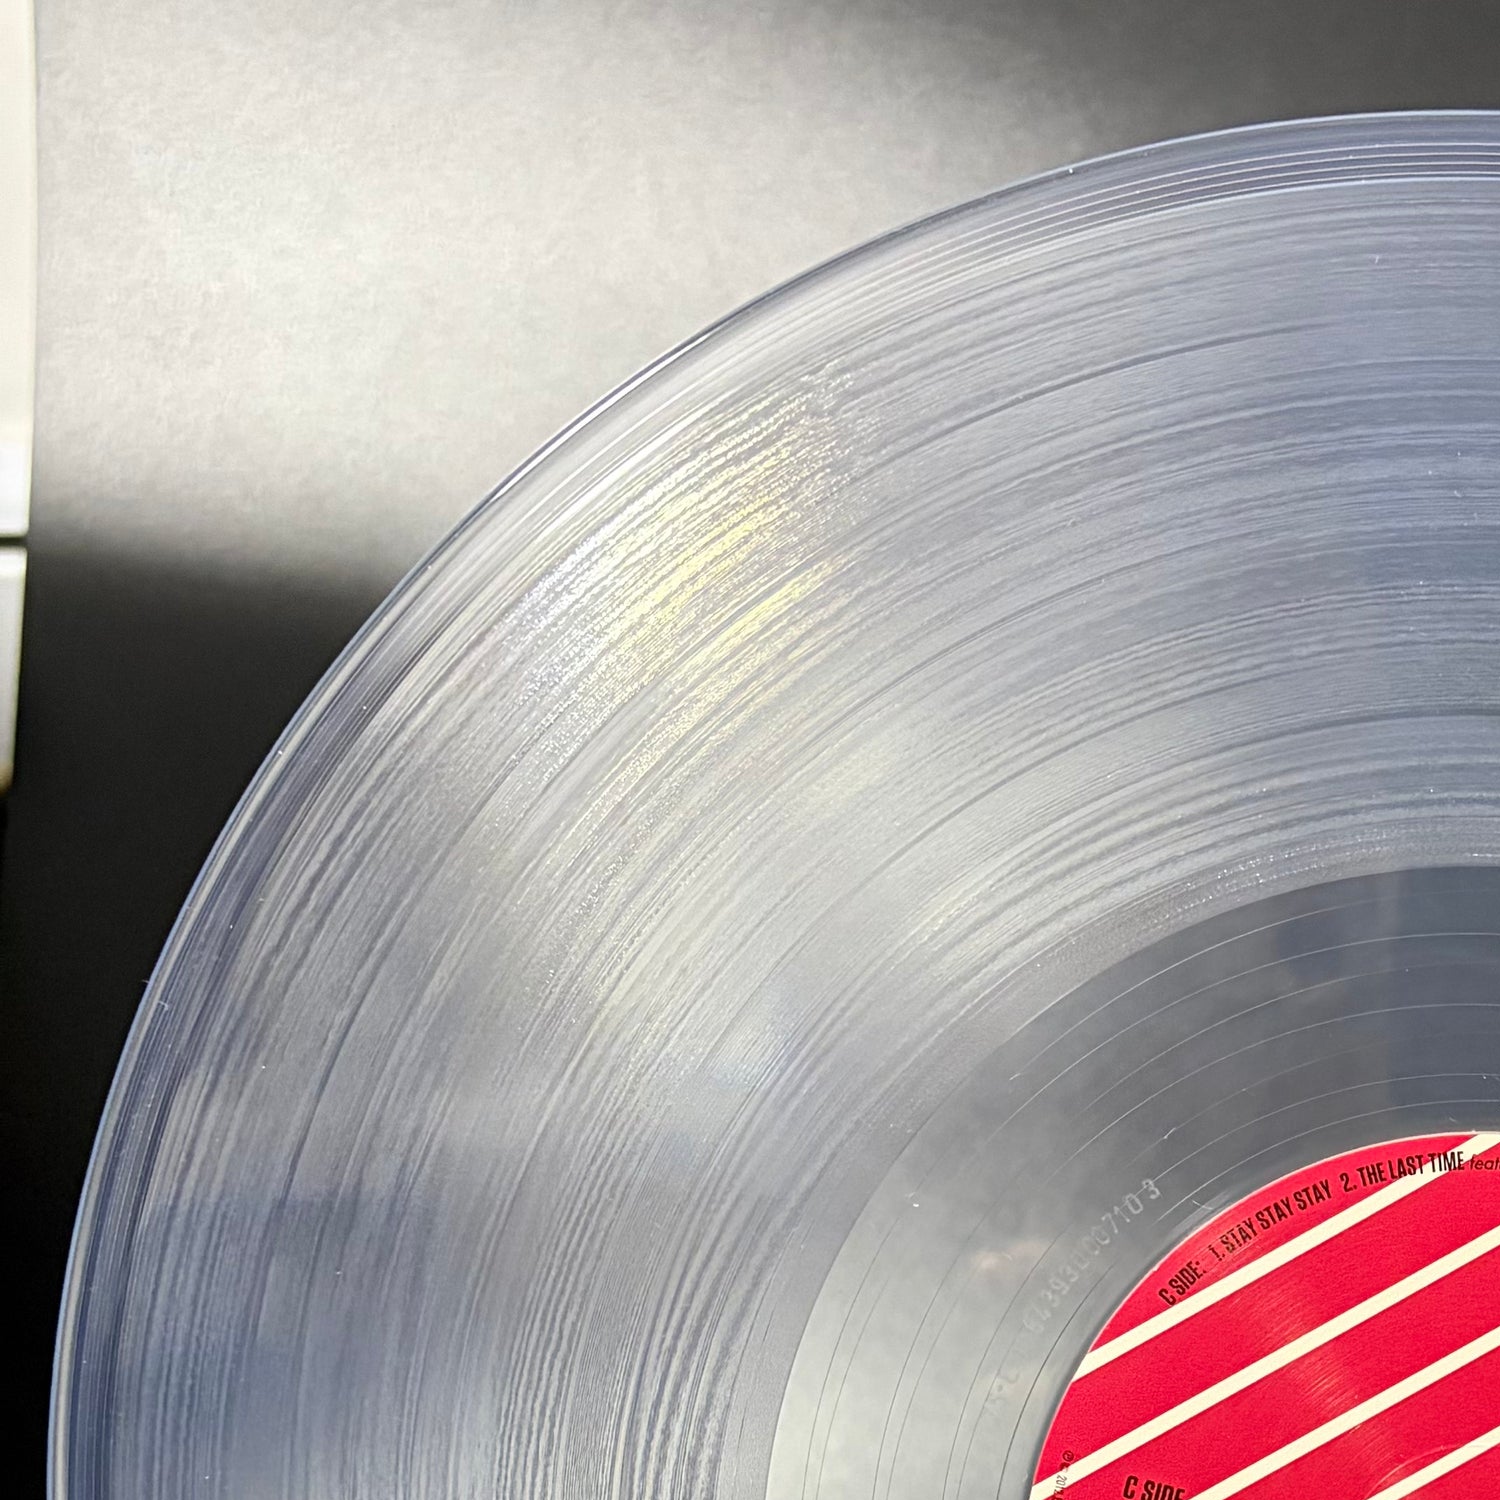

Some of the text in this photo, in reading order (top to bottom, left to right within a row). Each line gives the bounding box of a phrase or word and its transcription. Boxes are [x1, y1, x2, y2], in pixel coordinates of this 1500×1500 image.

[1158, 1288, 1177, 1306] C
[1168, 1260, 1207, 1297] SIDE:
[1220, 1217, 1258, 1255] STAY
[1255, 1196, 1294, 1230] STAY
[1296, 1179, 1332, 1211] STAY
[1339, 1172, 1357, 1193] 2.
[1357, 1161, 1387, 1186] THE
[1387, 1153, 1425, 1183] LAST
[1428, 1151, 1464, 1173] TIME
[1123, 1475, 1139, 1500] C
